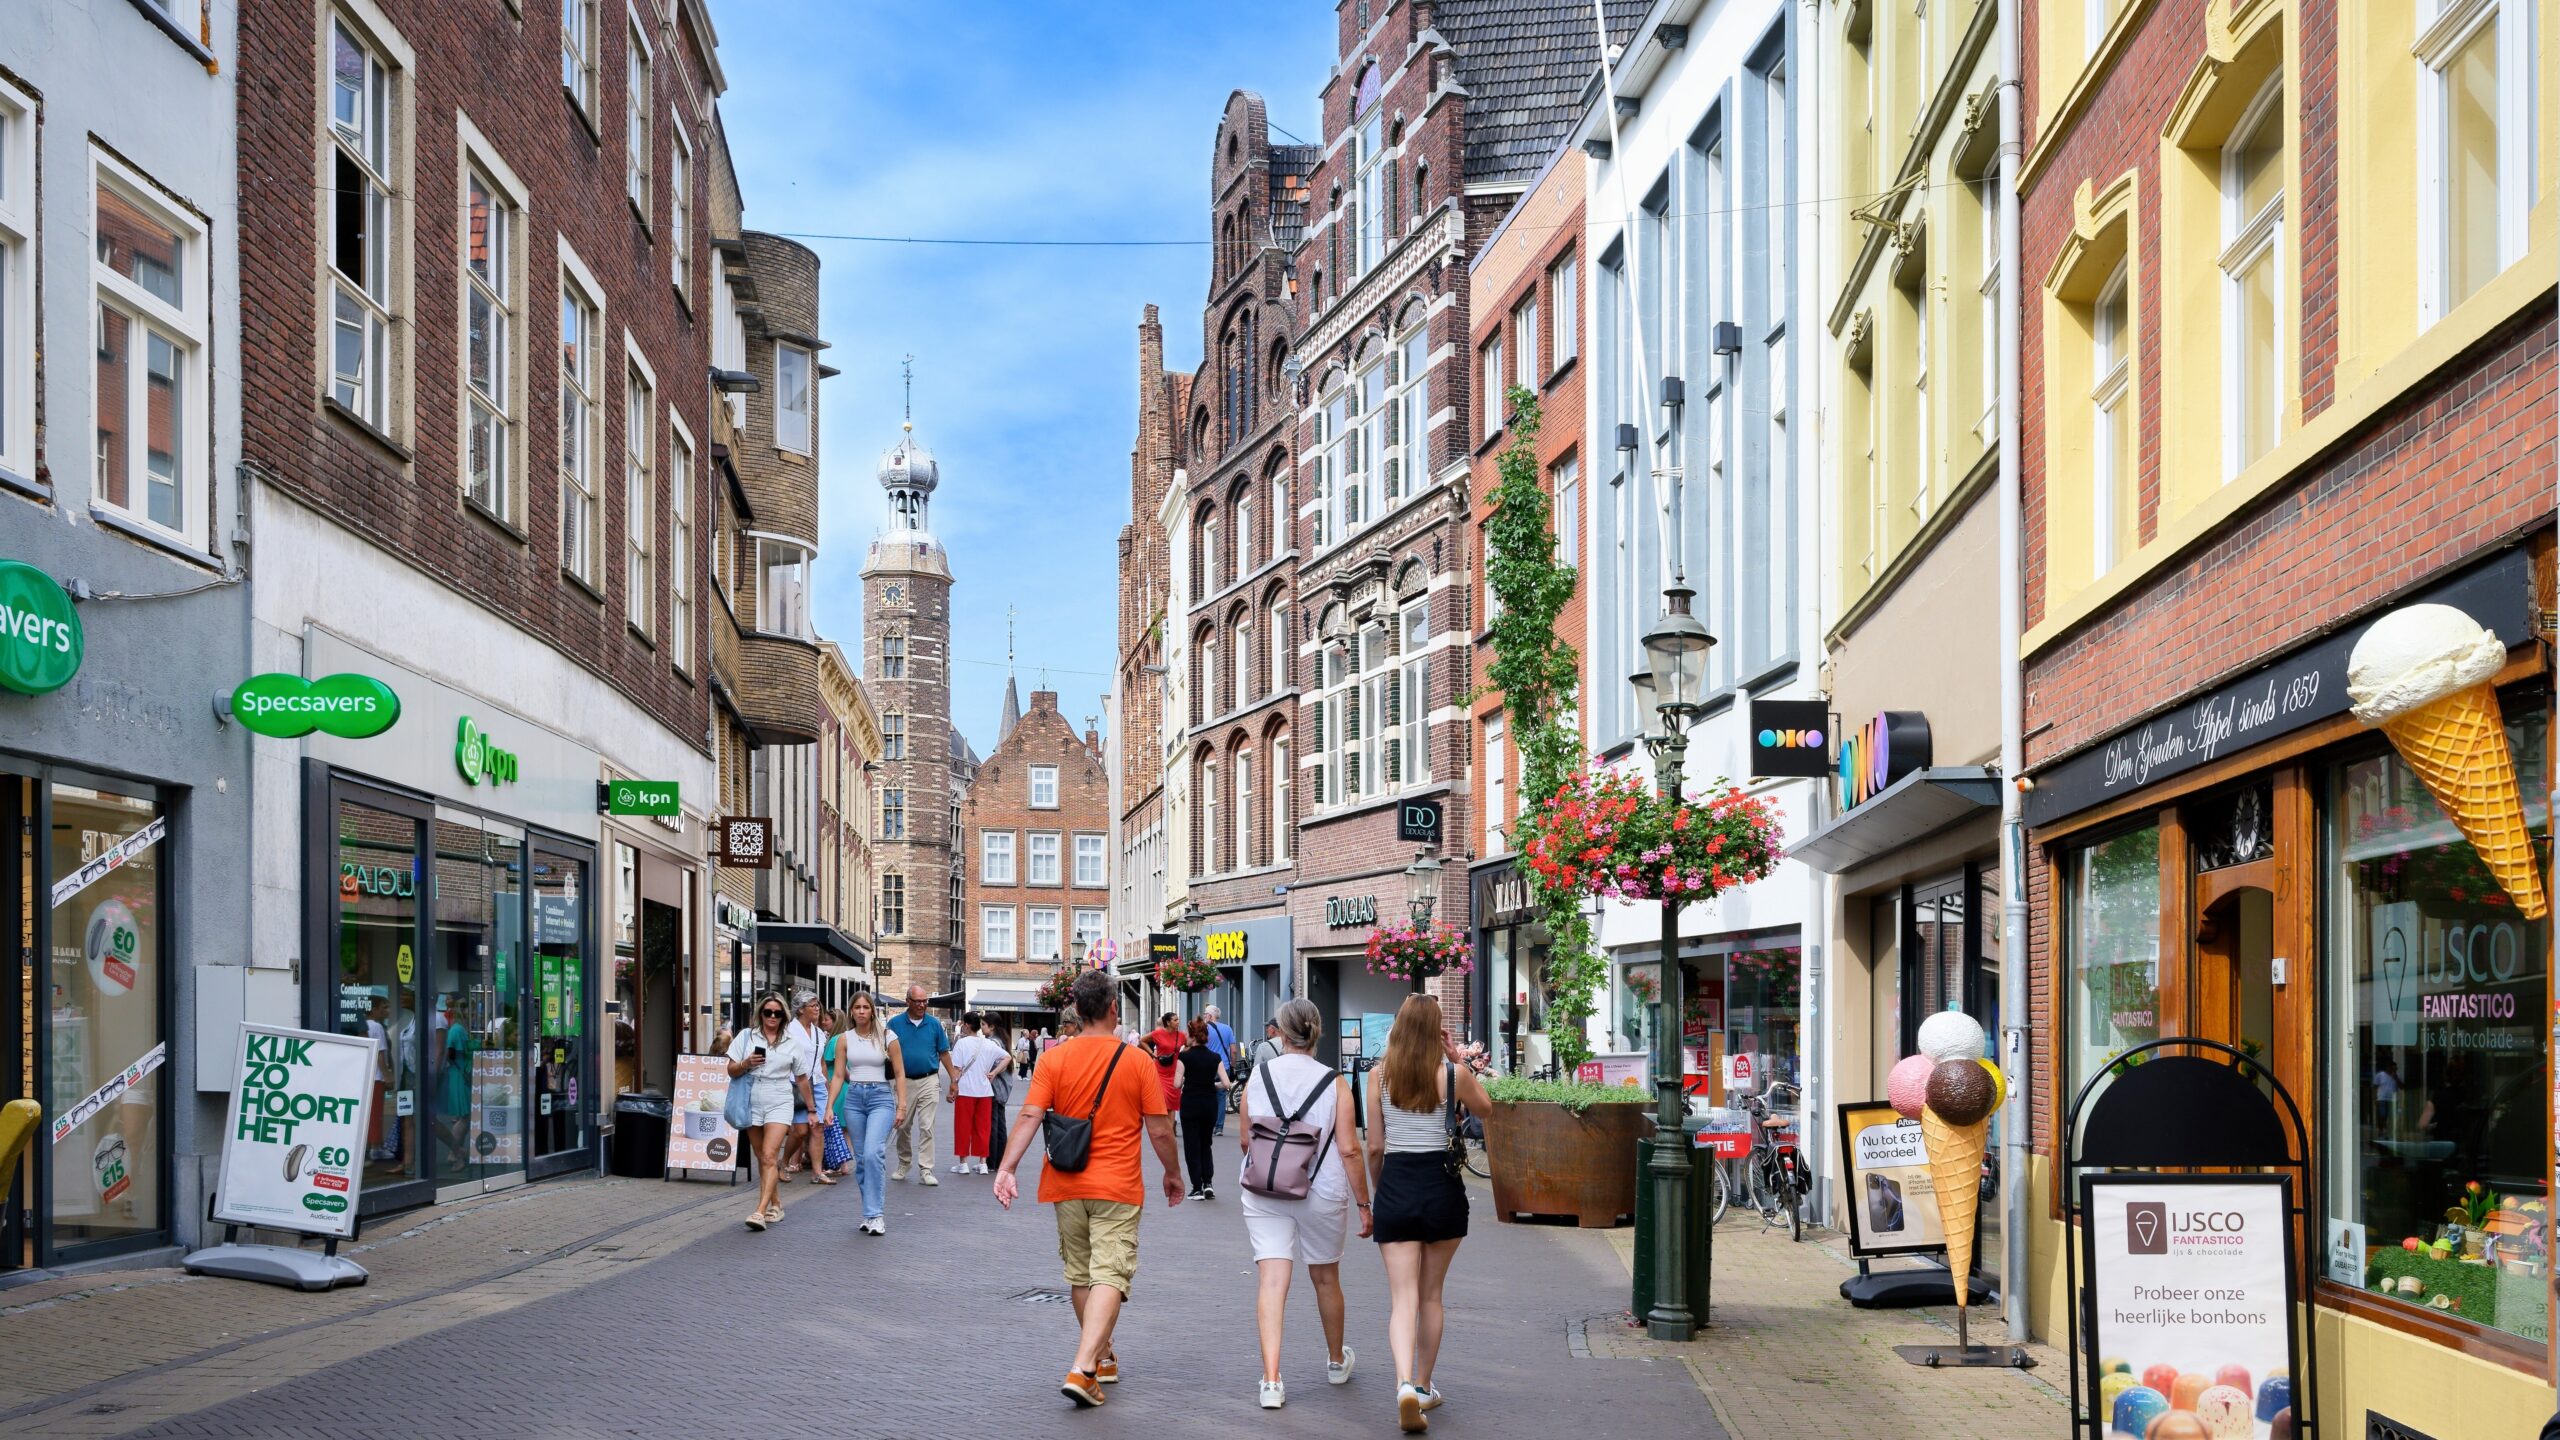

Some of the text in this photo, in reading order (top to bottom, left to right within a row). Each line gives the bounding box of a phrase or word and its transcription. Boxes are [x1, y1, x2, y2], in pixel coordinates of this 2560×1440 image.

[242, 691, 376, 716] Specsavers
[2104, 736, 2133, 788] Den
[2238, 679, 2277, 728] sinds
[2281, 670, 2320, 713] 1859
[482, 733, 518, 786] kpn
[639, 789, 671, 806] kpn
[1405, 806, 1435, 827] DO
[1405, 829, 1435, 837] DOUGLAS
[1325, 895, 1375, 926] DOUGLAS
[113, 926, 135, 954] €0
[1206, 930, 1245, 960] xenos
[2424, 922, 2516, 984] IJSCO
[340, 983, 372, 995] Combineer
[340, 997, 372, 1011] meer, krijg
[2423, 993, 2515, 1018] FANTASTICO
[340, 1013, 357, 1022] meer.
[2113, 1010, 2152, 1027] FANTASTICO
[2450, 1025, 2513, 1049] chocolade
[246, 1034, 316, 1066] KIJK
[243, 1061, 289, 1090] ZO
[1583, 1065, 1599, 1075] 1+1
[241, 1088, 359, 1124] HOORT
[672, 1106, 684, 1116] IC
[237, 1114, 300, 1145] HET
[1714, 1141, 1735, 1152] TIE
[1862, 1136, 1879, 1147] Nu
[1881, 1134, 1897, 1146] tot
[318, 1147, 350, 1167] €0
[1864, 1147, 1917, 1160] voordeel
[102, 1159, 125, 1188] €15
[306, 1197, 345, 1207] Specsavers
[2172, 1212, 2244, 1232] IJSCO
[2173, 1236, 2243, 1245] FANTASTICO
[2134, 1285, 2245, 1301] Probeer onze
[2115, 1309, 2266, 1327] heerlijke bonbons
